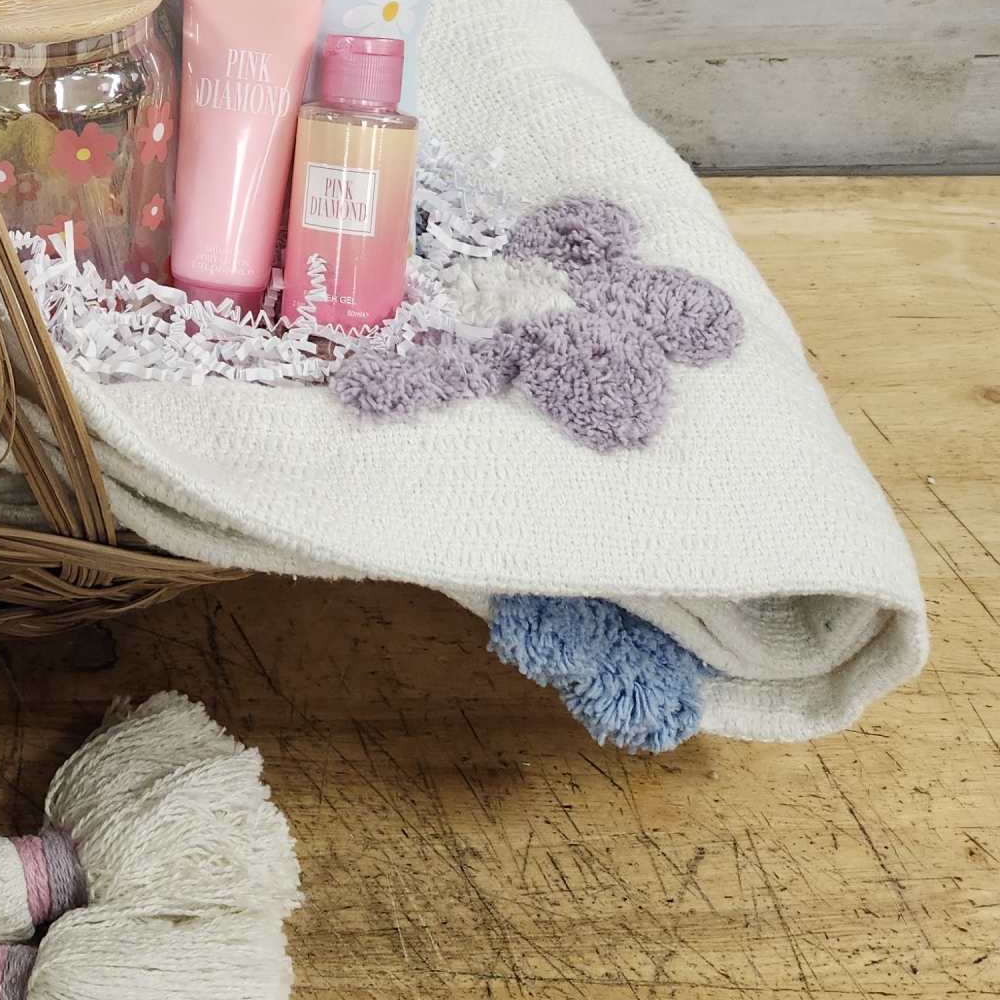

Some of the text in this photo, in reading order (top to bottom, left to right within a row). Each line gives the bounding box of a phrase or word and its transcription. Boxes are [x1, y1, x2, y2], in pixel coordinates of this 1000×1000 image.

[226, 49, 273, 82] PINK
[196, 77, 291, 118] DIAMOND
[324, 177, 353, 200] PINK
[310, 195, 367, 222] DIAMOND
